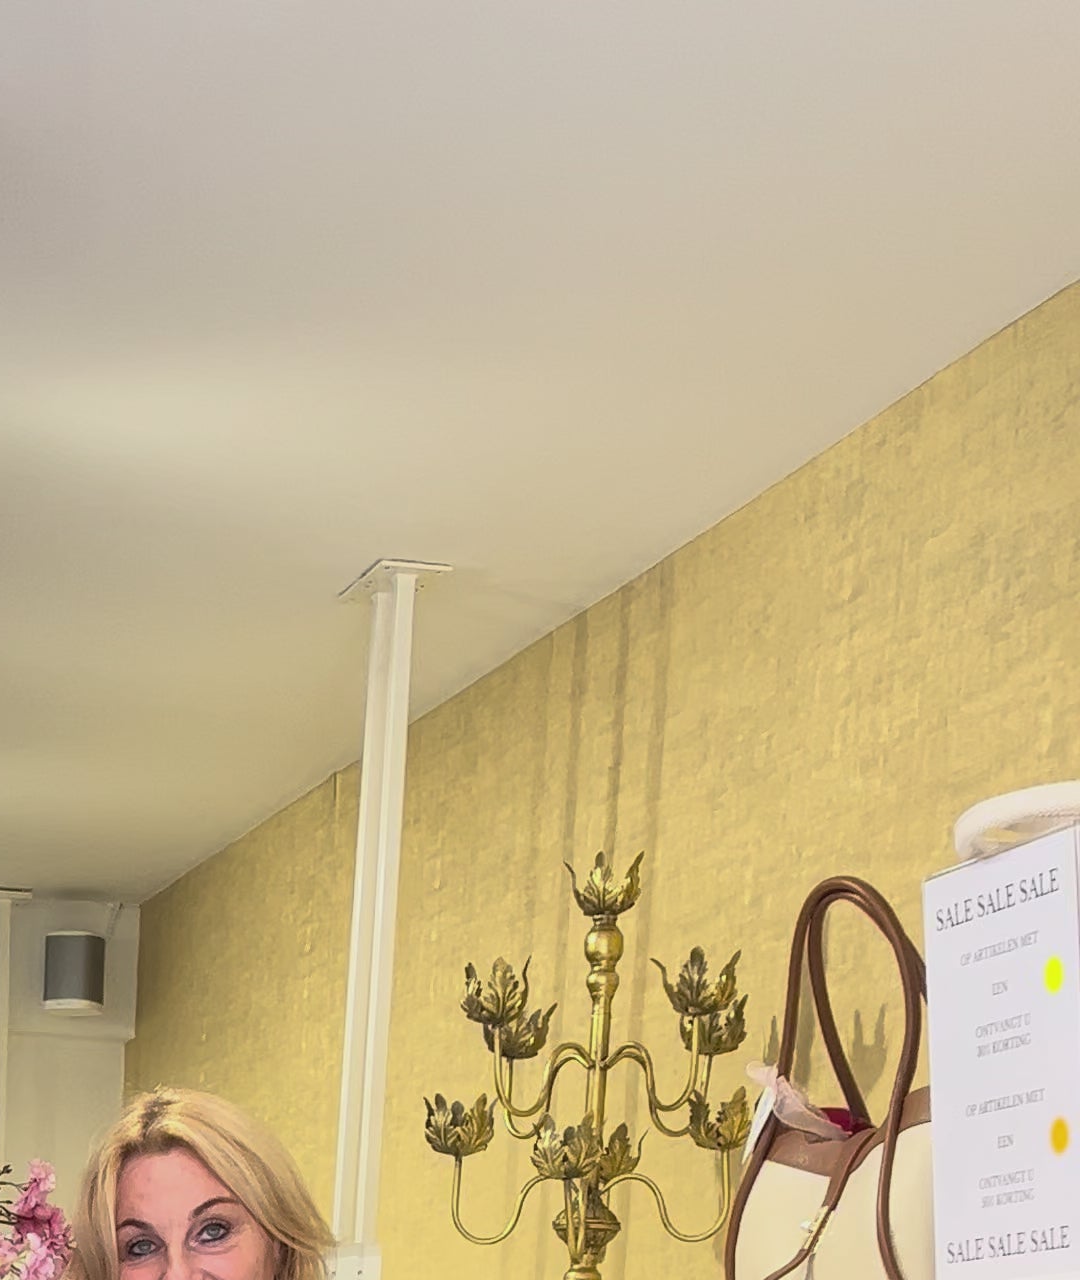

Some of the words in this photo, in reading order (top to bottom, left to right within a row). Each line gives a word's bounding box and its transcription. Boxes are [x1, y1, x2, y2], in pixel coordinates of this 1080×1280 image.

[936, 898, 974, 932] SALE
[977, 883, 1016, 918] SALE
[1019, 867, 1059, 903] SALE
[946, 1237, 985, 1264] SALE
[988, 1231, 1026, 1258] SALE
[1030, 1225, 1070, 1253] SALE
